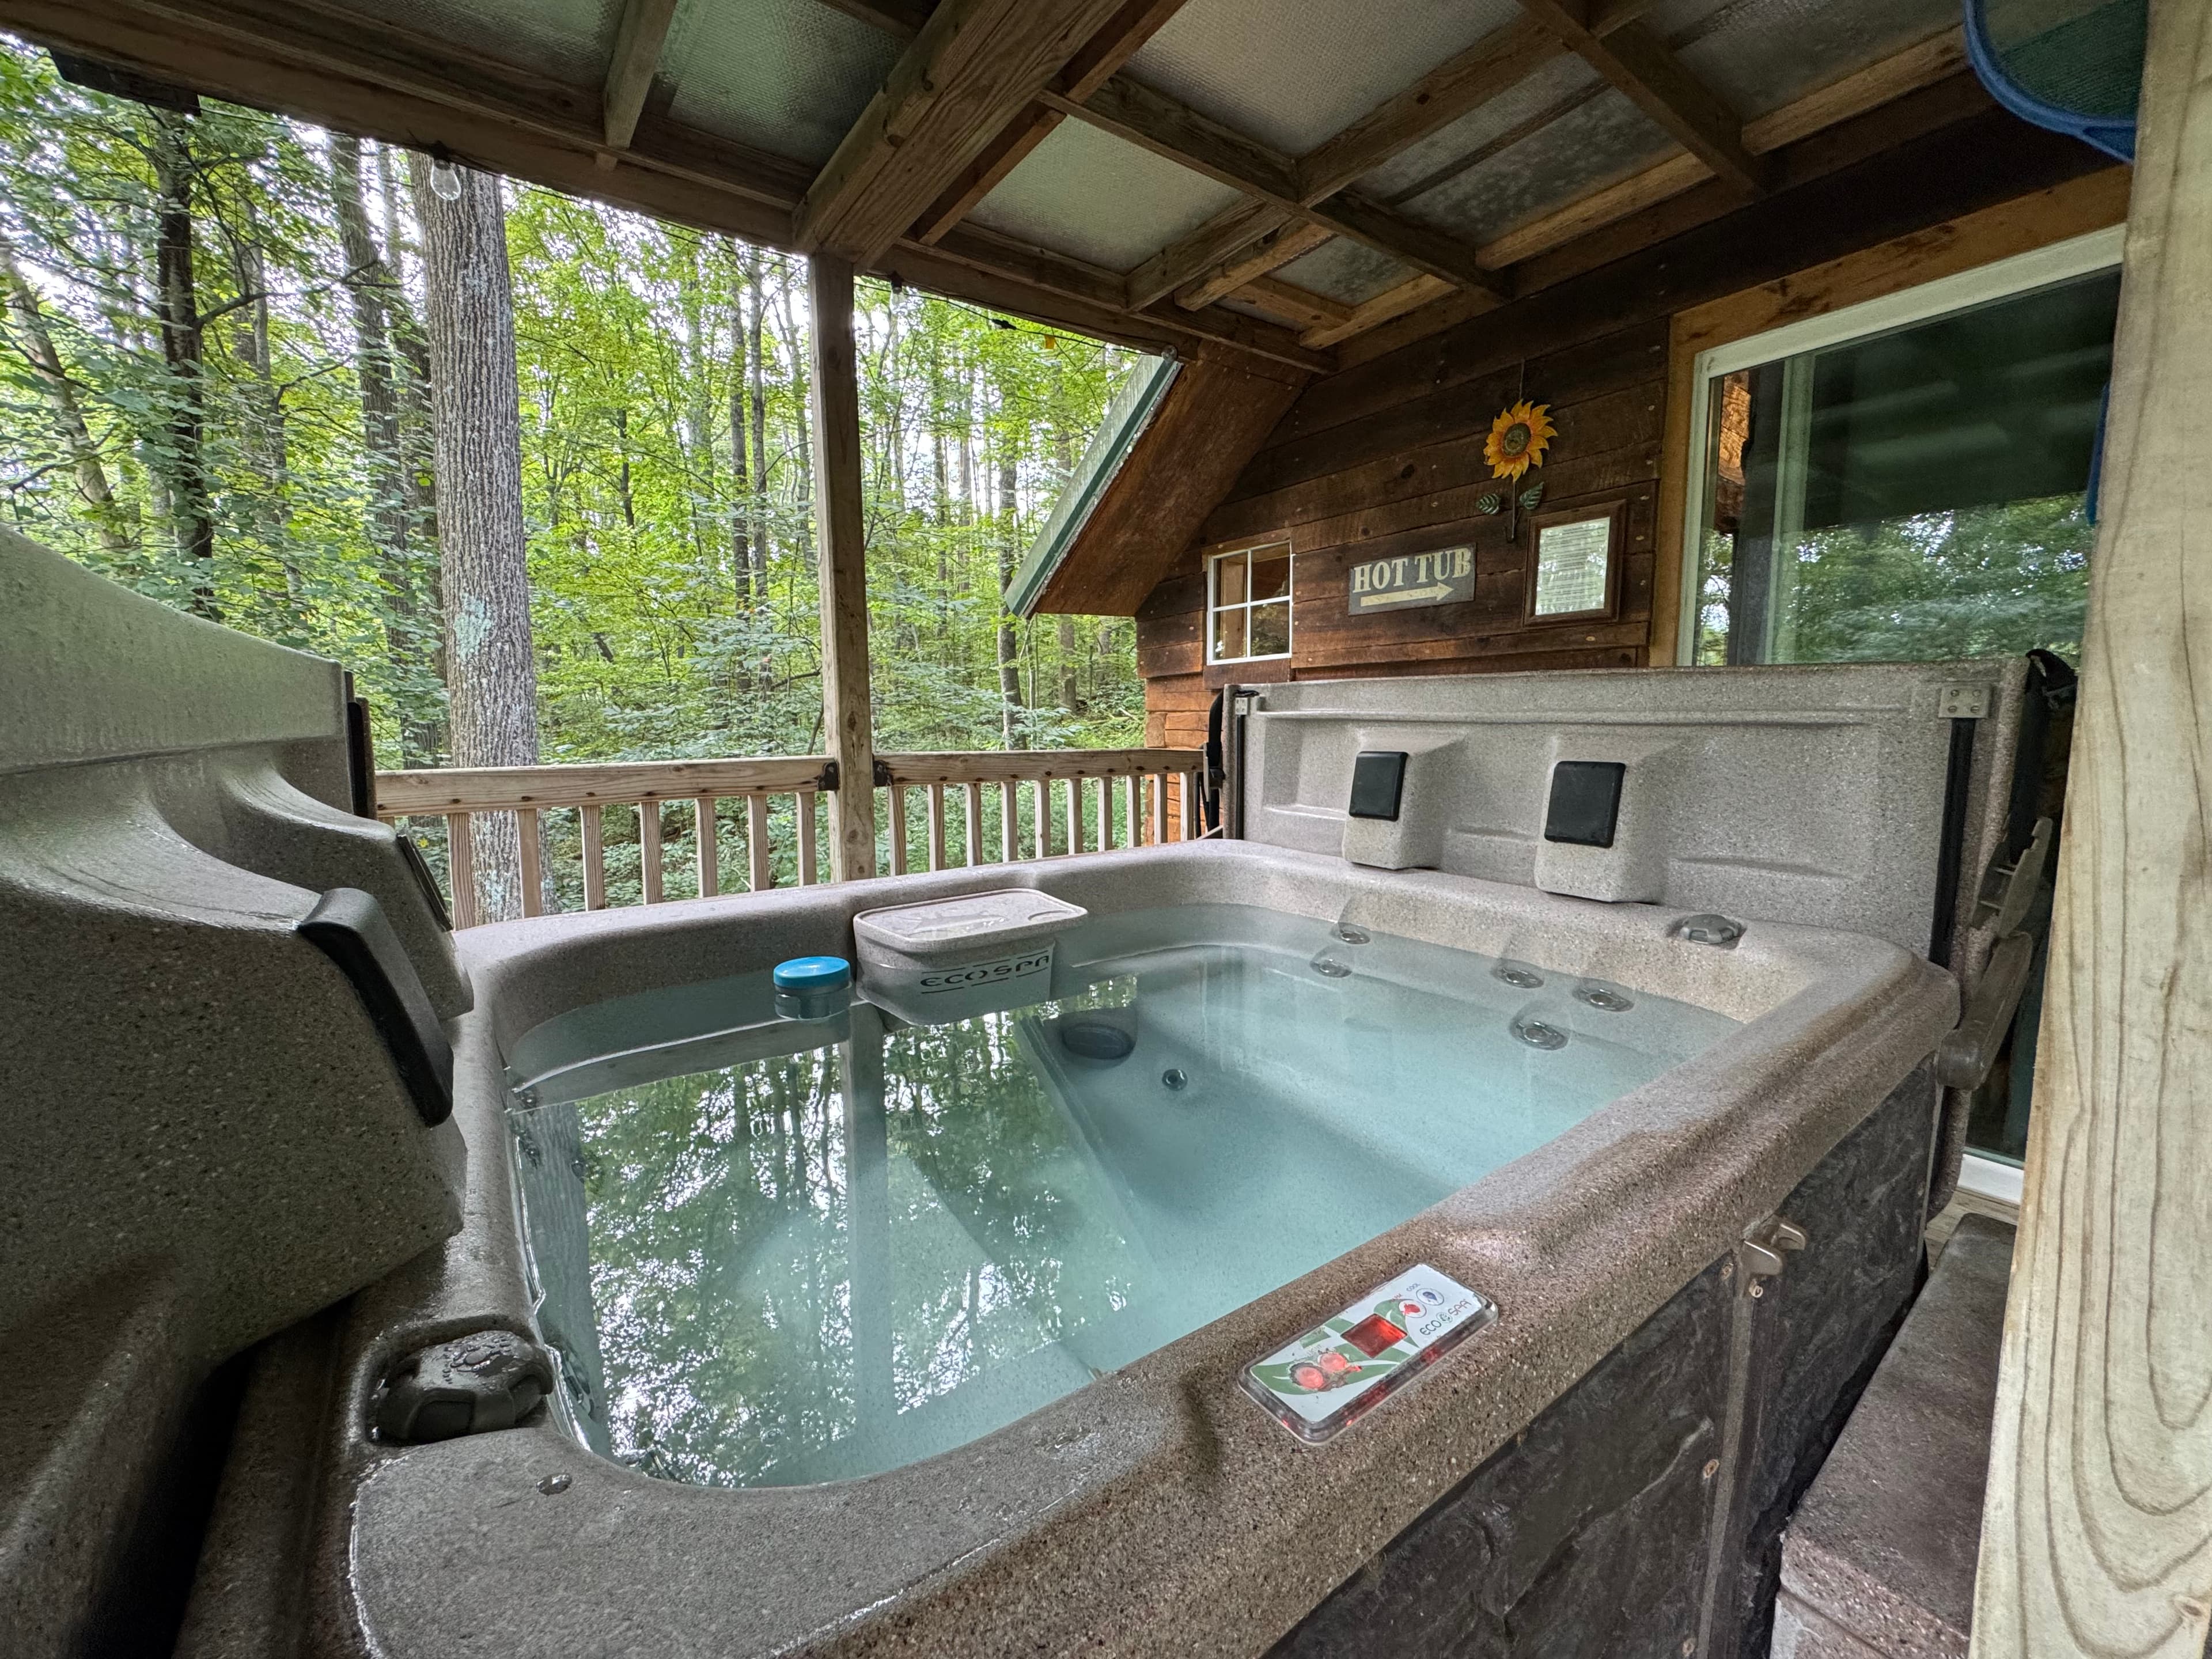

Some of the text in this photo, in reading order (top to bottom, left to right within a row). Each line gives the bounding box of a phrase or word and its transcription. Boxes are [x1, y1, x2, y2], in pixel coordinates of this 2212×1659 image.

[1353, 548, 1471, 593] HOT TUB
[1406, 1282, 1421, 1292] COOL
[1419, 1299, 1472, 1335] ECO SPA
